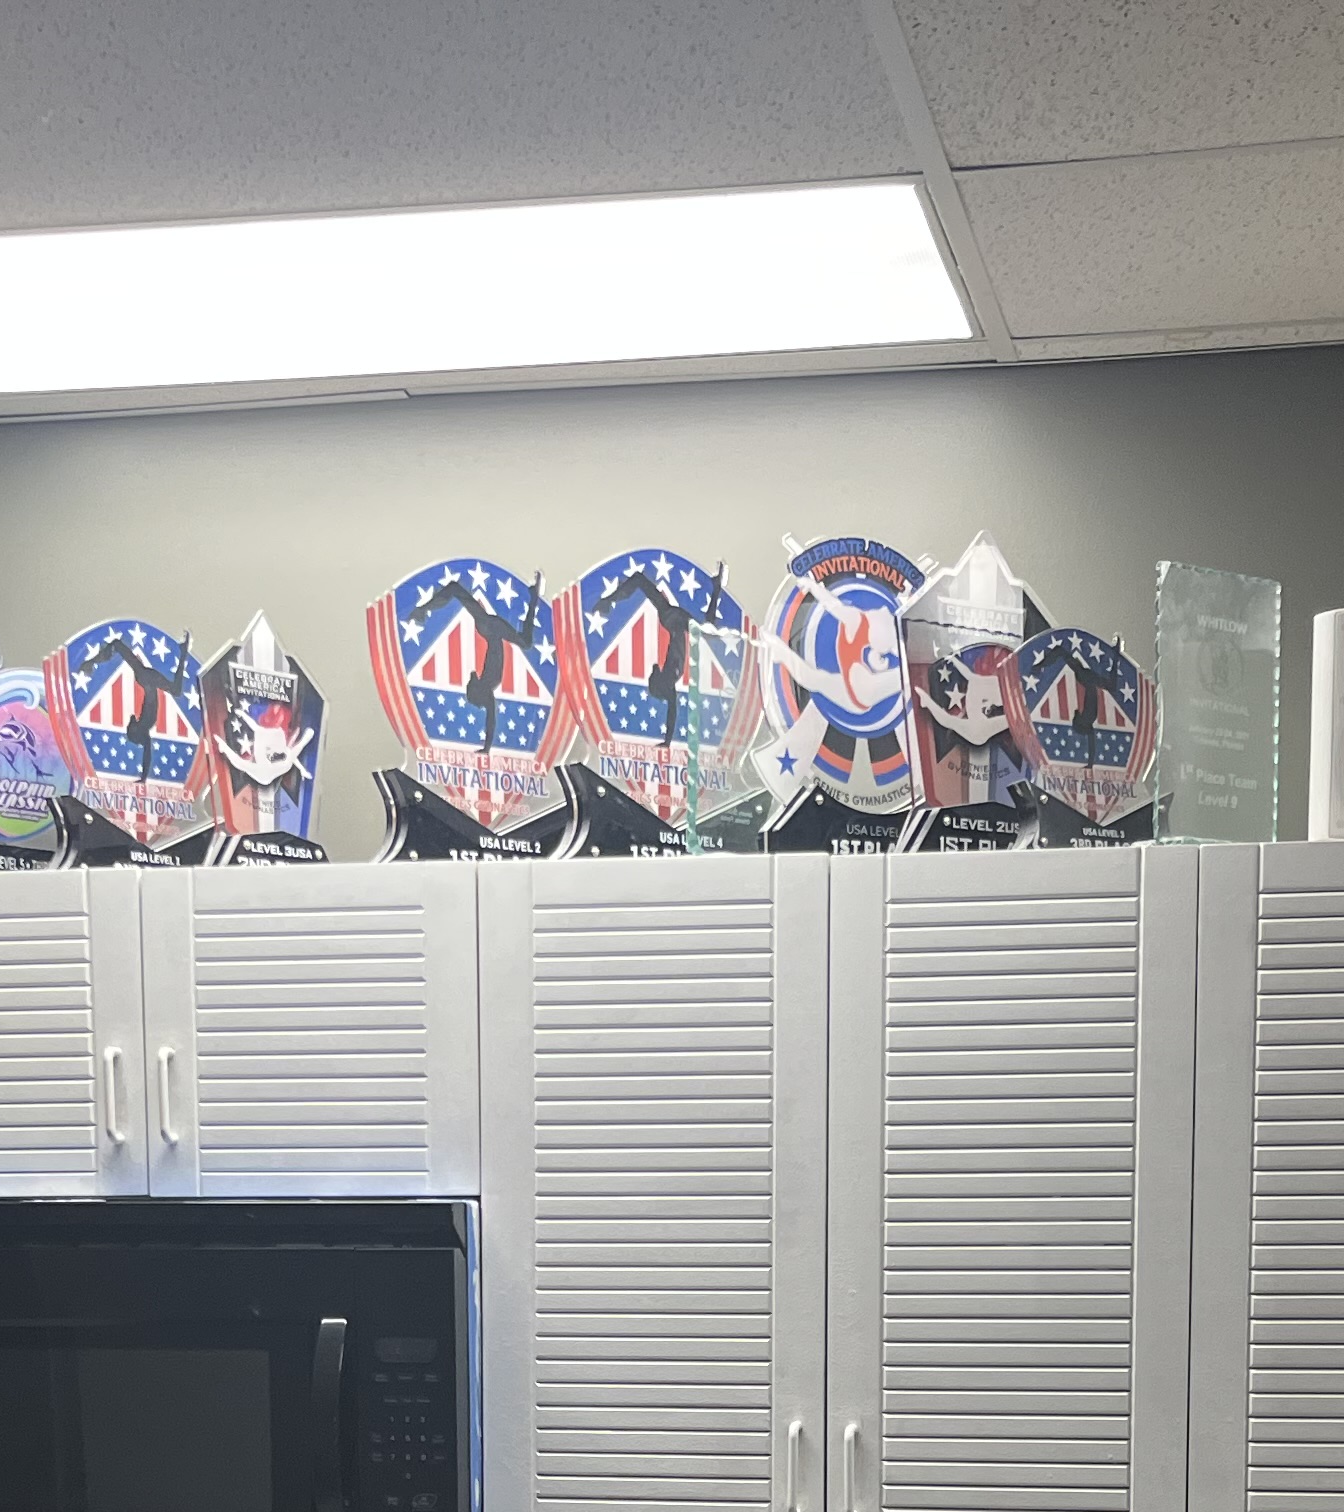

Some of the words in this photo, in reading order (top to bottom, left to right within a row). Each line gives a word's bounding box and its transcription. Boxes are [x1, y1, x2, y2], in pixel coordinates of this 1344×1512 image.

[792, 538, 865, 577] CELEBRATE
[866, 541, 925, 589] AMERICA
[811, 556, 906, 591] INVITATIONAL
[236, 670, 292, 688] CELEBRATE
[242, 679, 286, 695] AMERICA
[237, 686, 291, 703] INVITATIONAL
[598, 739, 669, 762] CELEBRATE
[416, 747, 489, 769] CELEBRATE
[491, 756, 547, 776] AMERICA
[84, 777, 145, 795] CELEBRATE
[417, 763, 549, 797] INVITATIONAL
[1042, 773, 1138, 798] INVITATIONAL
[813, 777, 850, 803] GENIE'S
[852, 783, 912, 807] GYMNASTICS
[86, 790, 196, 820] INVITATIONAL
[846, 824, 867, 835] USA
[870, 826, 900, 838] LEVEL
[952, 817, 993, 832] LEVEL
[1082, 827, 1097, 837] USA
[1098, 829, 1118, 838] LEVEL
[251, 842, 283, 856] LEVEL
[479, 836, 501, 850] USA
[502, 839, 533, 853] LEVEL
[534, 842, 541, 854] 2
[660, 832, 680, 845] USA
[681, 834, 715, 848] LVEL
[716, 837, 723, 849] 4
[831, 839, 861, 855] 1ST
[130, 851, 148, 862] USA
[149, 853, 174, 865] LEVEL
[449, 849, 479, 861] 1ST
[630, 845, 659, 857] 1ST
